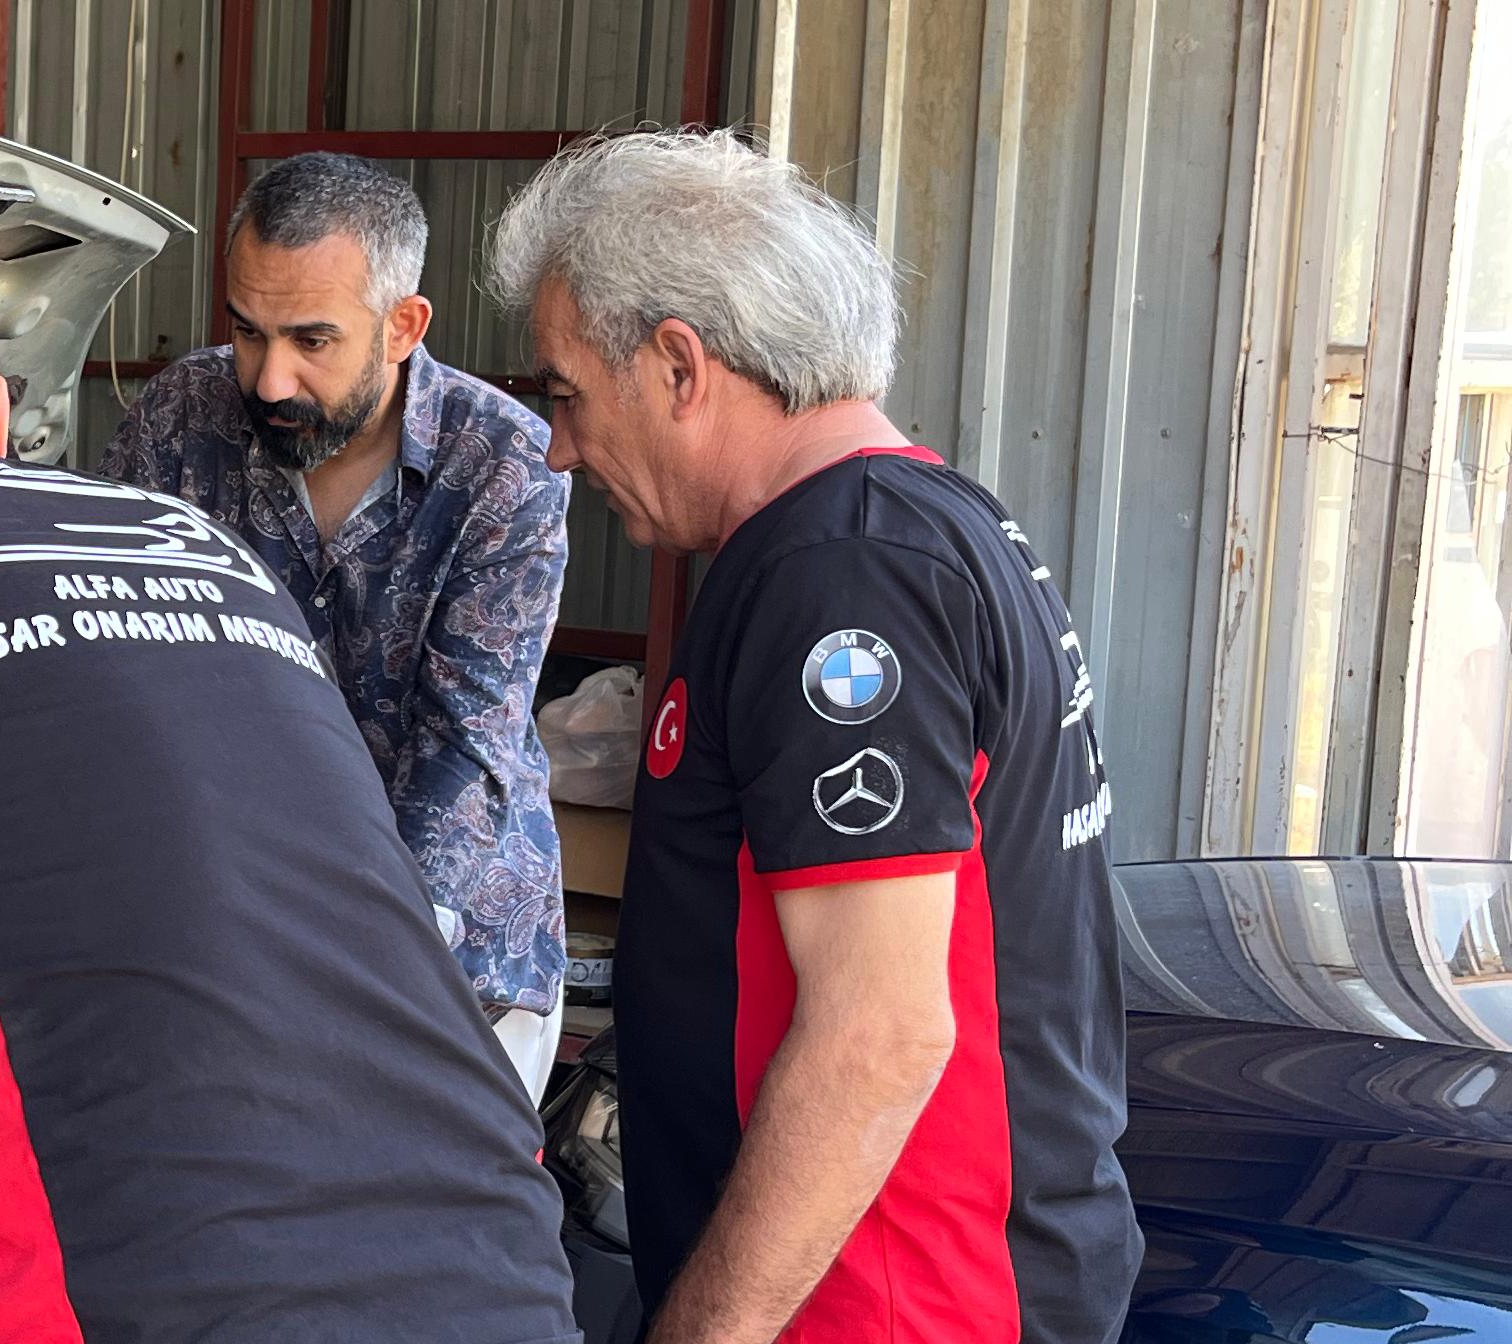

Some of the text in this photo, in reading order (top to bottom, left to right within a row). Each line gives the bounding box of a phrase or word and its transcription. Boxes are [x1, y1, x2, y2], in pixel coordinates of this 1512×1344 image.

[53, 574, 224, 603] ALFA AUTO
[72, 610, 217, 643] ONARIM
[217, 613, 326, 679] MERKEZİ
[812, 632, 890, 665] BMW
